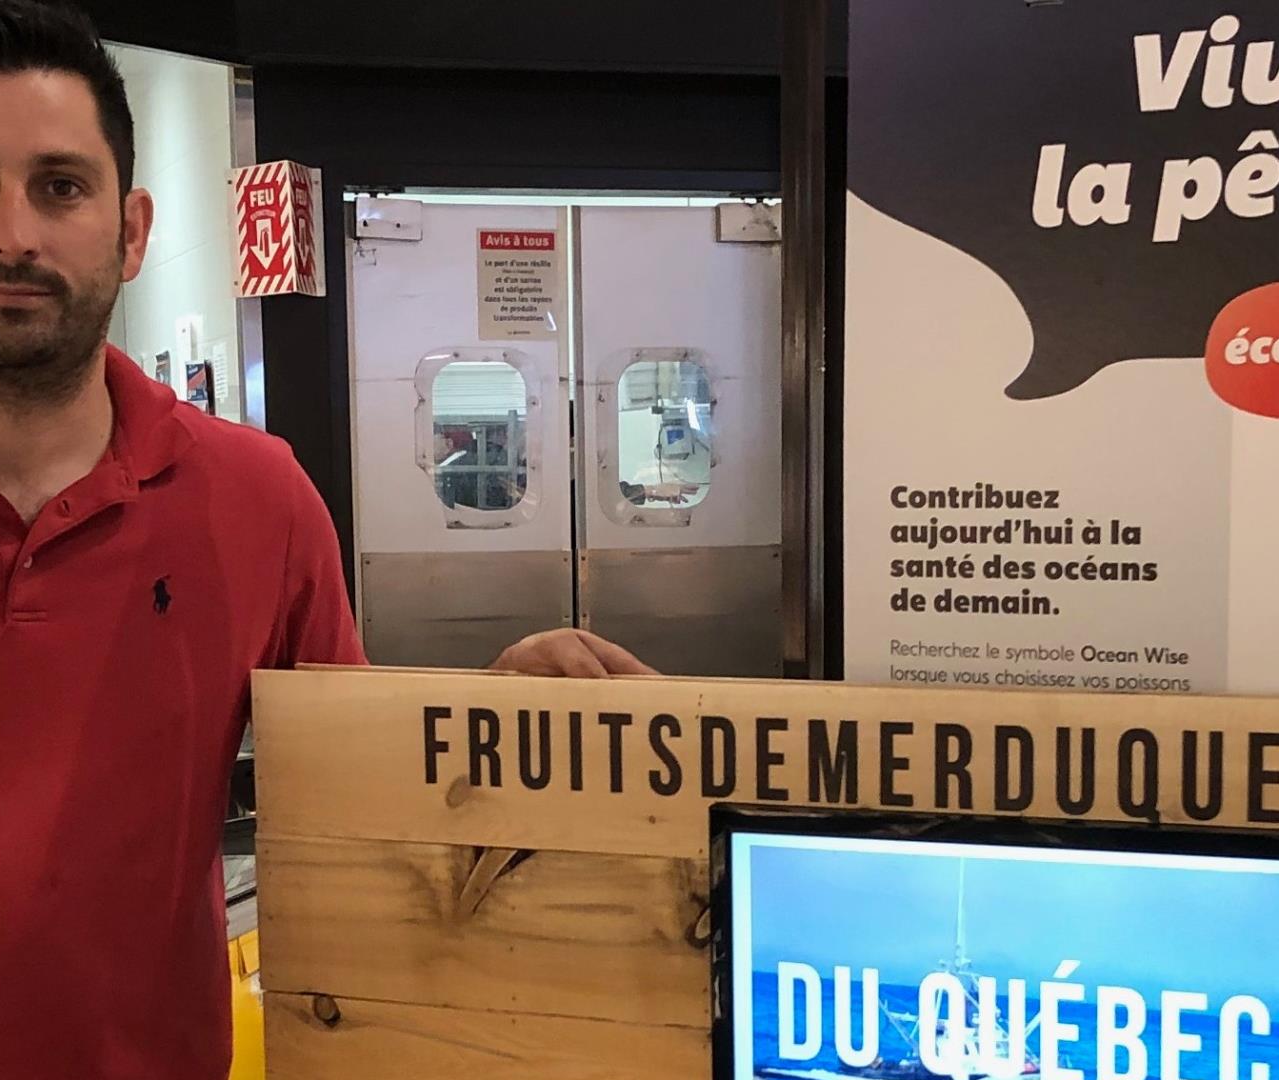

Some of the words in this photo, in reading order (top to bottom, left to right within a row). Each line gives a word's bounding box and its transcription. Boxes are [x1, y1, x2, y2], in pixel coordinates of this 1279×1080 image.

[250, 188, 274, 207] FEU
[1032, 144, 1132, 229] la
[486, 235, 511, 247] Avis
[513, 235, 521, 247] à
[523, 235, 549, 247] tous
[890, 482, 1060, 509] Contribuez
[890, 517, 1073, 549] aujourd'hui
[1081, 520, 1101, 545] à
[1111, 520, 1141, 545] la
[890, 554, 975, 579] santé
[982, 555, 1036, 579] des
[1044, 555, 1158, 582] océans
[890, 588, 926, 612] de
[933, 588, 1060, 615] demain.
[890, 639, 980, 659] Recherchez
[986, 642, 1000, 660] le
[1005, 641, 1075, 662] symbole
[1080, 645, 1139, 664] Ocean
[1144, 646, 1190, 665] Wise
[890, 665, 947, 689] lorsque
[952, 670, 990, 684] vous
[995, 668, 1076, 688] choisissez
[1081, 675, 1109, 689] vos
[1115, 676, 1191, 692] poissons
[778, 961, 879, 1067] DU
